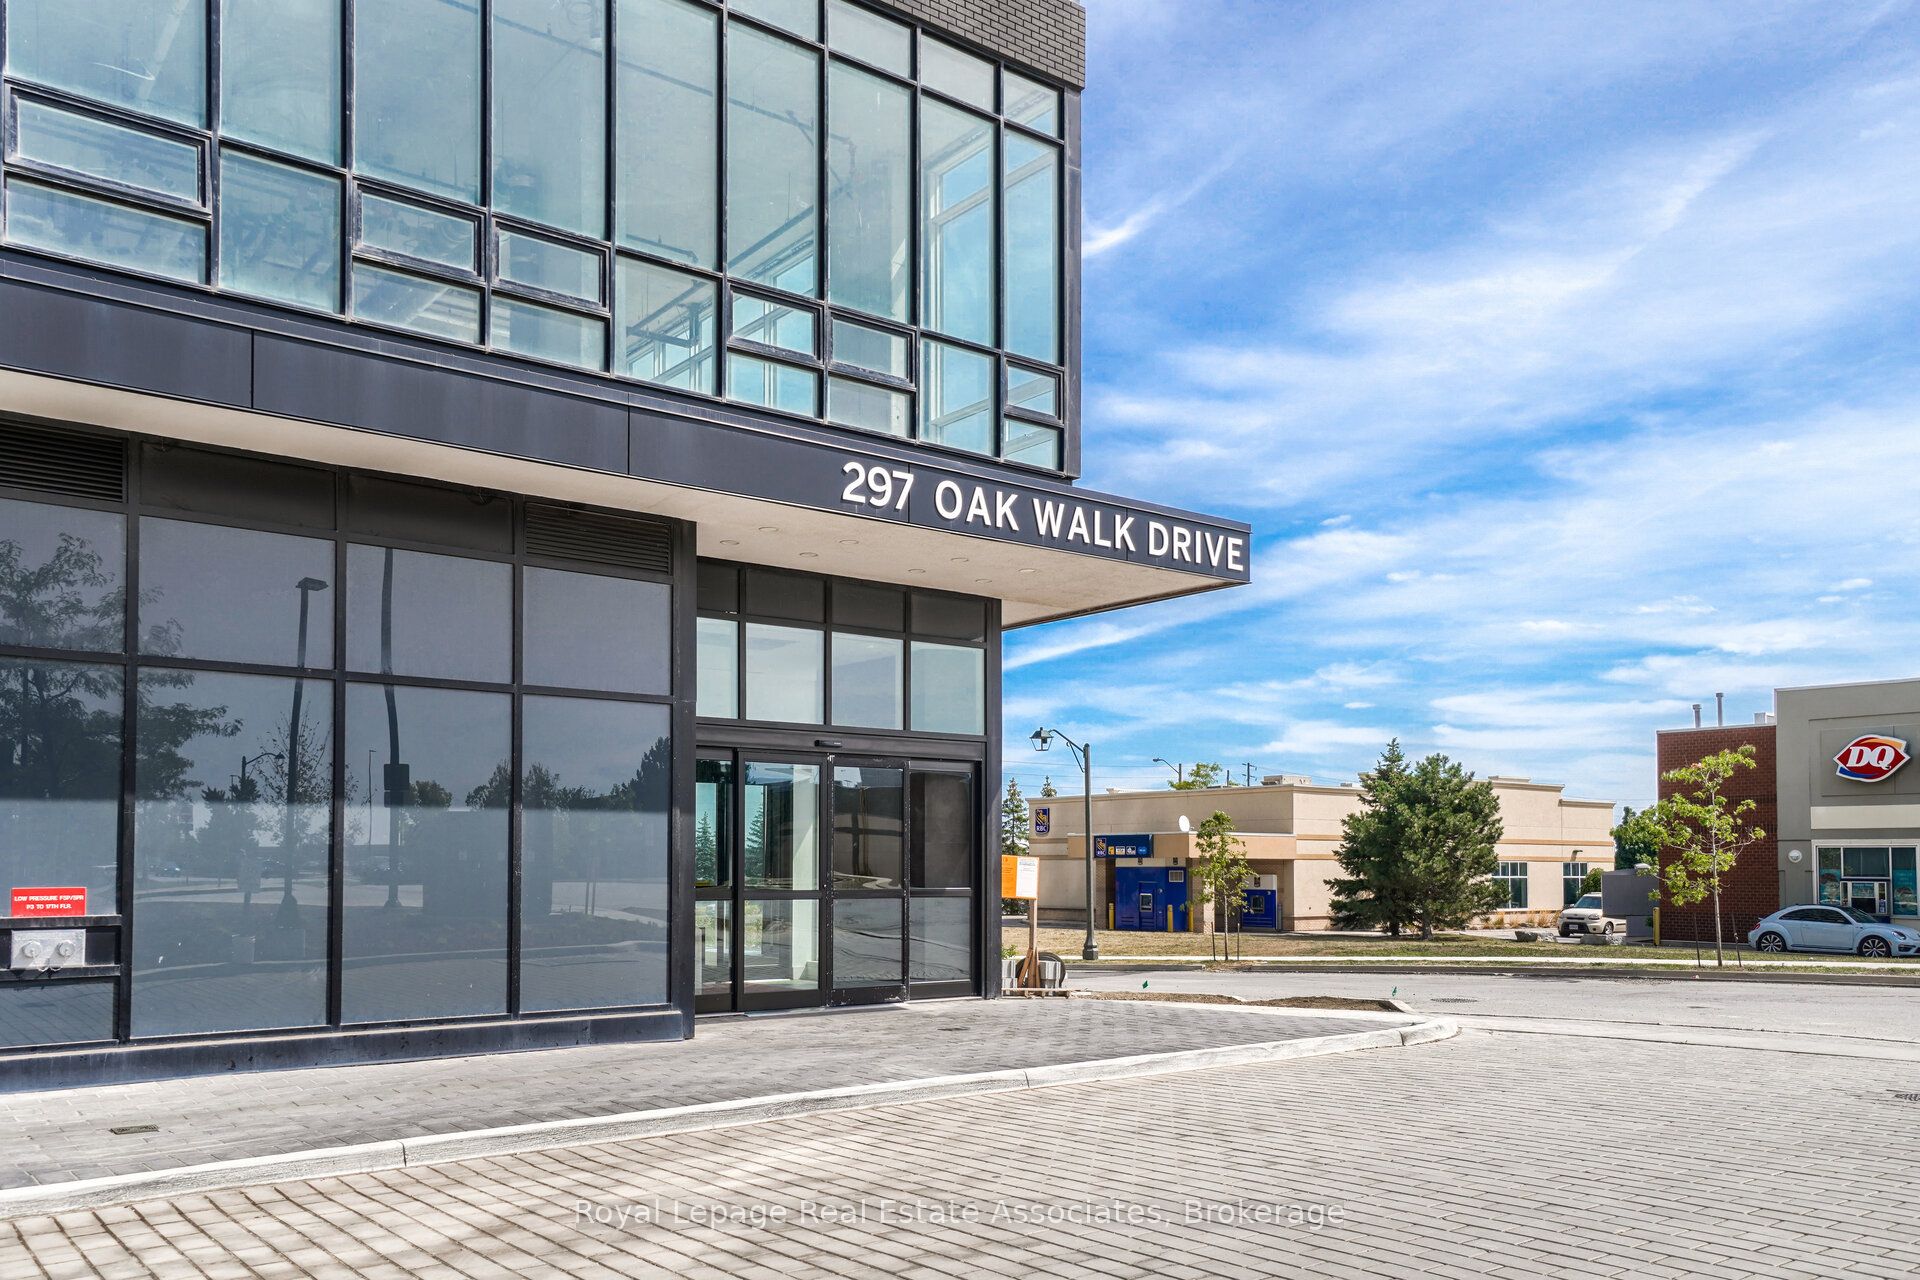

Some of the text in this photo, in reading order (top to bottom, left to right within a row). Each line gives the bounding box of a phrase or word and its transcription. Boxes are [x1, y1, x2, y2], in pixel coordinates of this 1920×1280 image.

[841, 461, 1244, 573] 297 OAK WALK DRIVE
[1846, 745, 1895, 770] DQ
